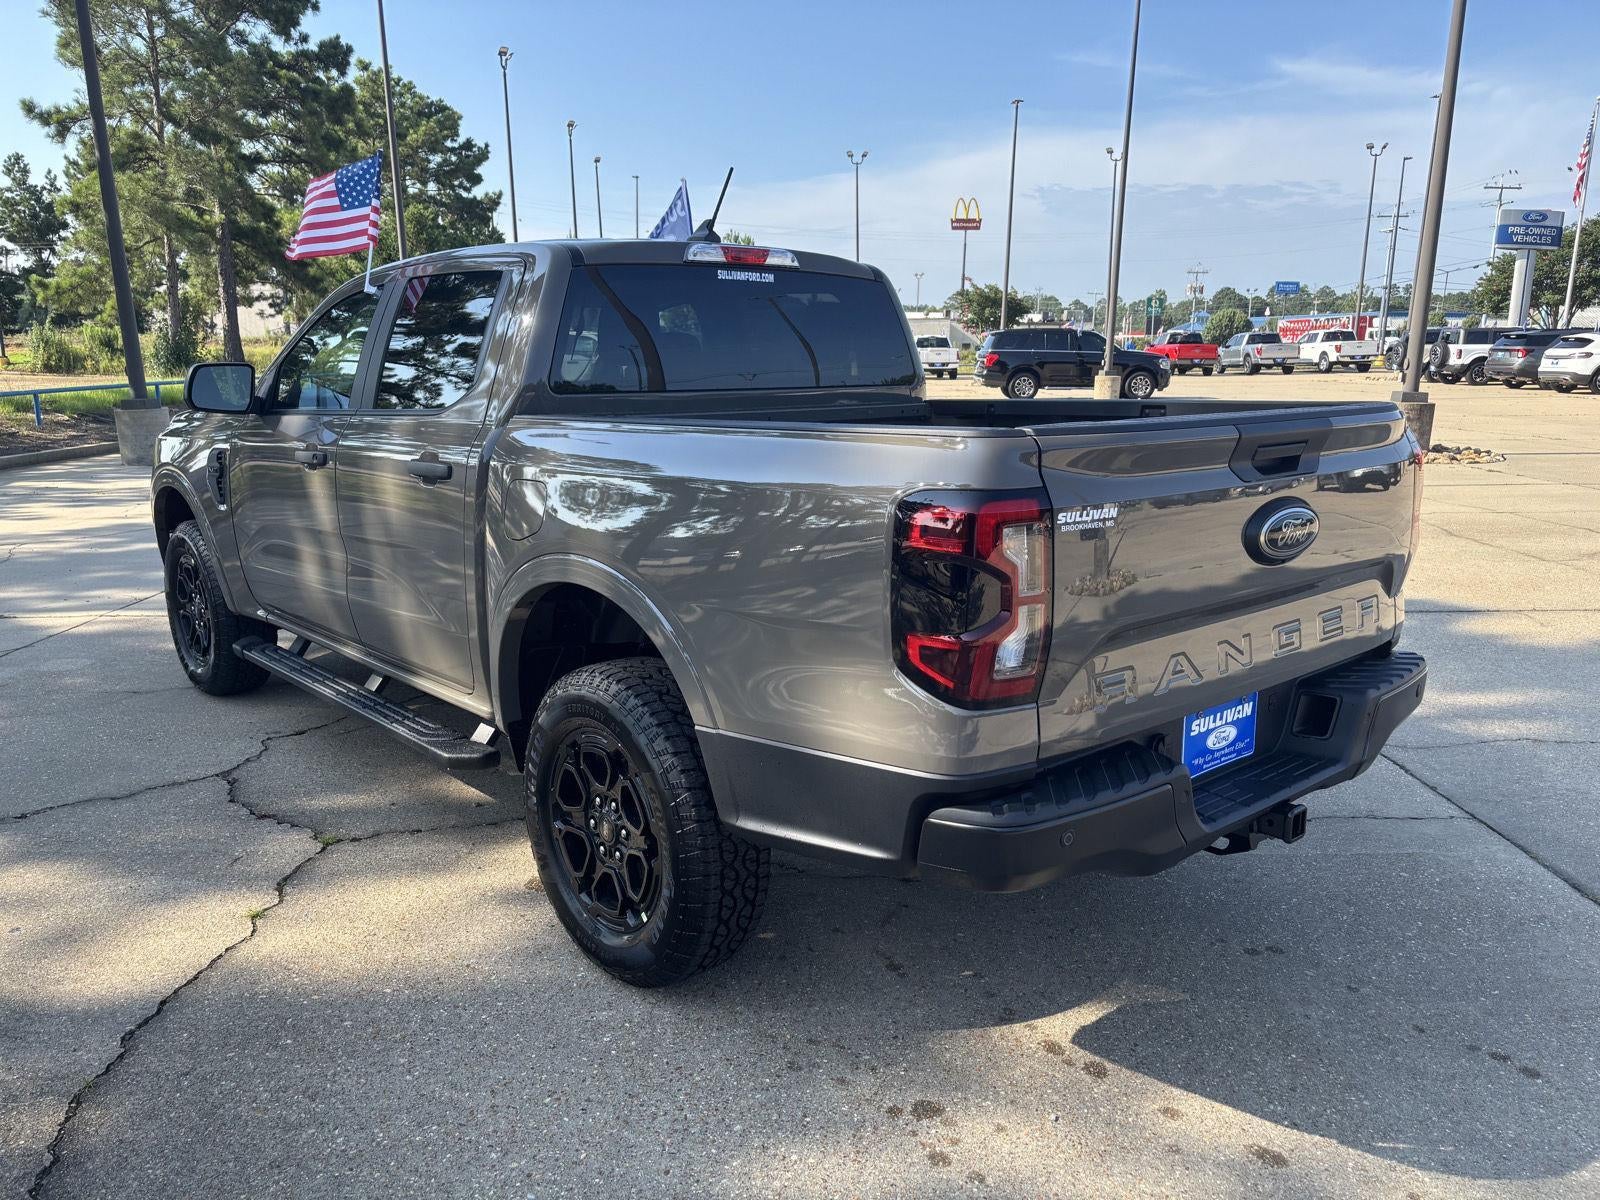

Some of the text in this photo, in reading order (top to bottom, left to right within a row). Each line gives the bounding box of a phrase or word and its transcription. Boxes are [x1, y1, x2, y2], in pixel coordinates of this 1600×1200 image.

[1508, 226, 1557, 236] PRE-OWNED
[1512, 235, 1552, 244] VEHICLES
[717, 269, 775, 283] SULLIVANFORD.COM
[1056, 507, 1118, 524] SULLIVAN
[1061, 519, 1115, 532] BROOKHAVEN, MS
[1277, 518, 1310, 546] Ford
[1093, 594, 1379, 713] RANGER
[1190, 701, 1253, 736] SULLIVAN
[1212, 729, 1231, 747] Ford
